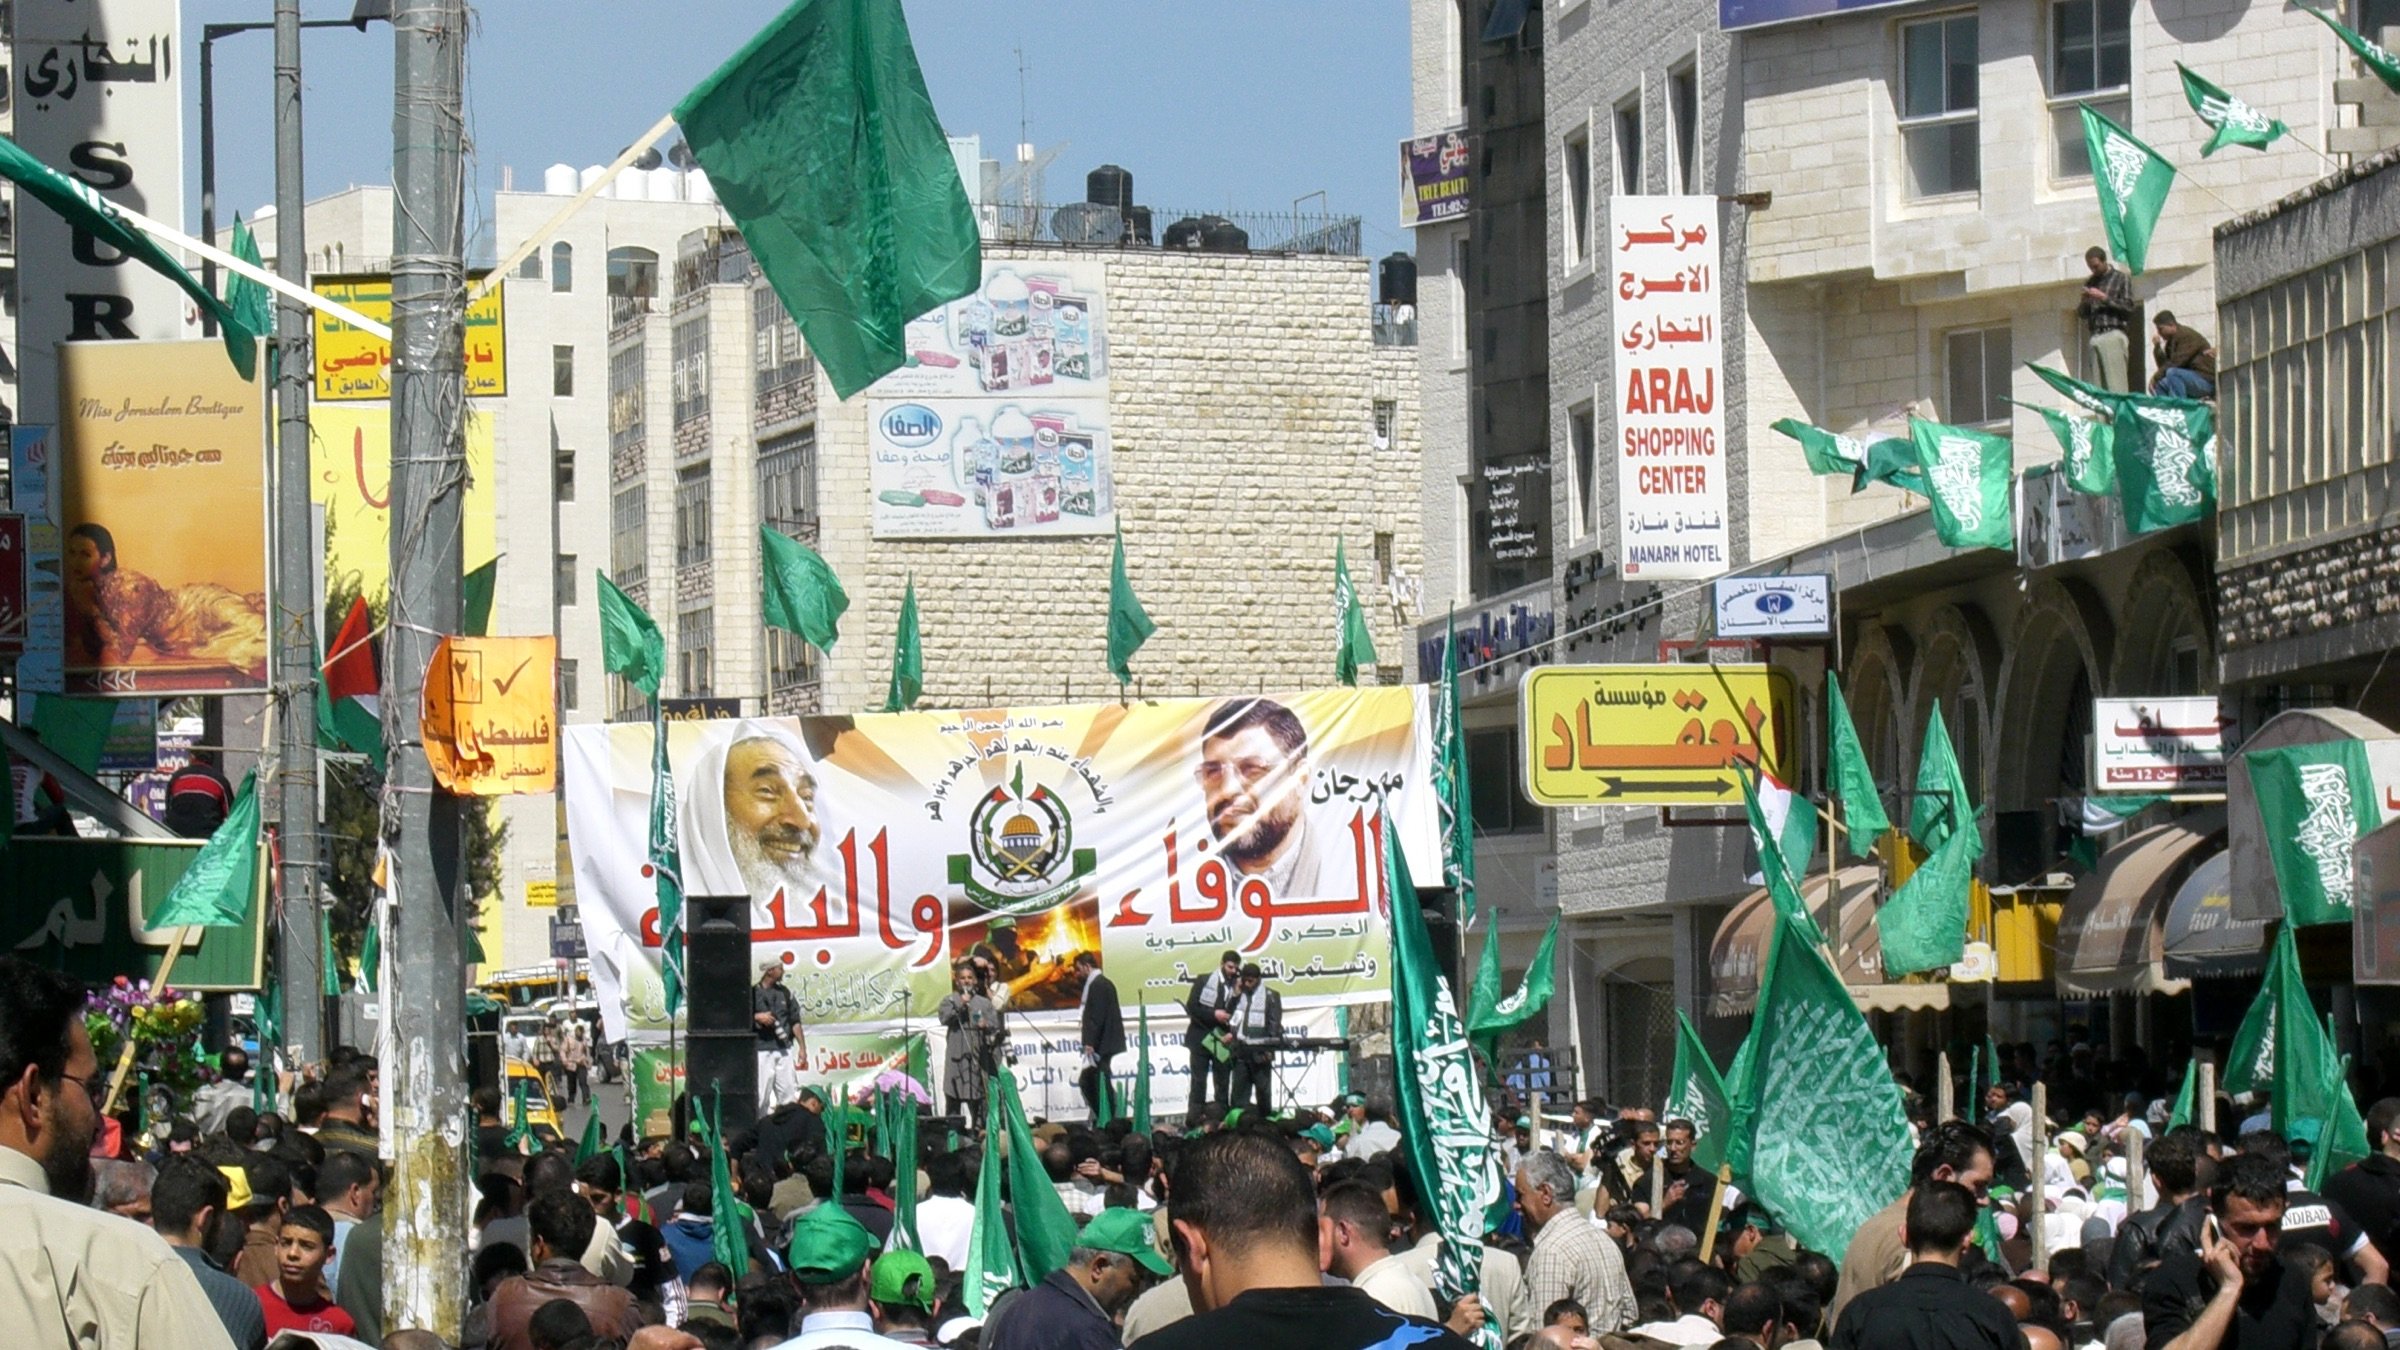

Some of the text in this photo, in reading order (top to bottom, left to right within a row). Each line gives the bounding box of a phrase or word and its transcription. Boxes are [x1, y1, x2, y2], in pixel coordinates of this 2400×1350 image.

[25, 27, 171, 111] التجاري
[1619, 214, 1707, 251] مركز
[1620, 264, 1709, 300] الاعرج
[1622, 314, 1711, 355] التجاري
[1626, 368, 1713, 414] ARAJ
[79, 395, 243, 422] Miss Jerusalem Boutique
[888, 416, 935, 438] الصفا
[1625, 427, 1714, 457] SHOPPING
[1639, 465, 1706, 495] CENTER
[1628, 510, 1720, 534] فندق منارة
[1629, 544, 1722, 563] MANARH HOTEL
[1764, 581, 1801, 593] الصفا
[1594, 681, 1666, 709] مؤسسة
[1545, 688, 1786, 771] العقاد
[1310, 767, 1405, 806] مهرجان
[2137, 769, 2152, 780] 12
[1146, 919, 1369, 952] الذكرى السنوية
[2283, 1207, 2328, 1227] NDIBAD
